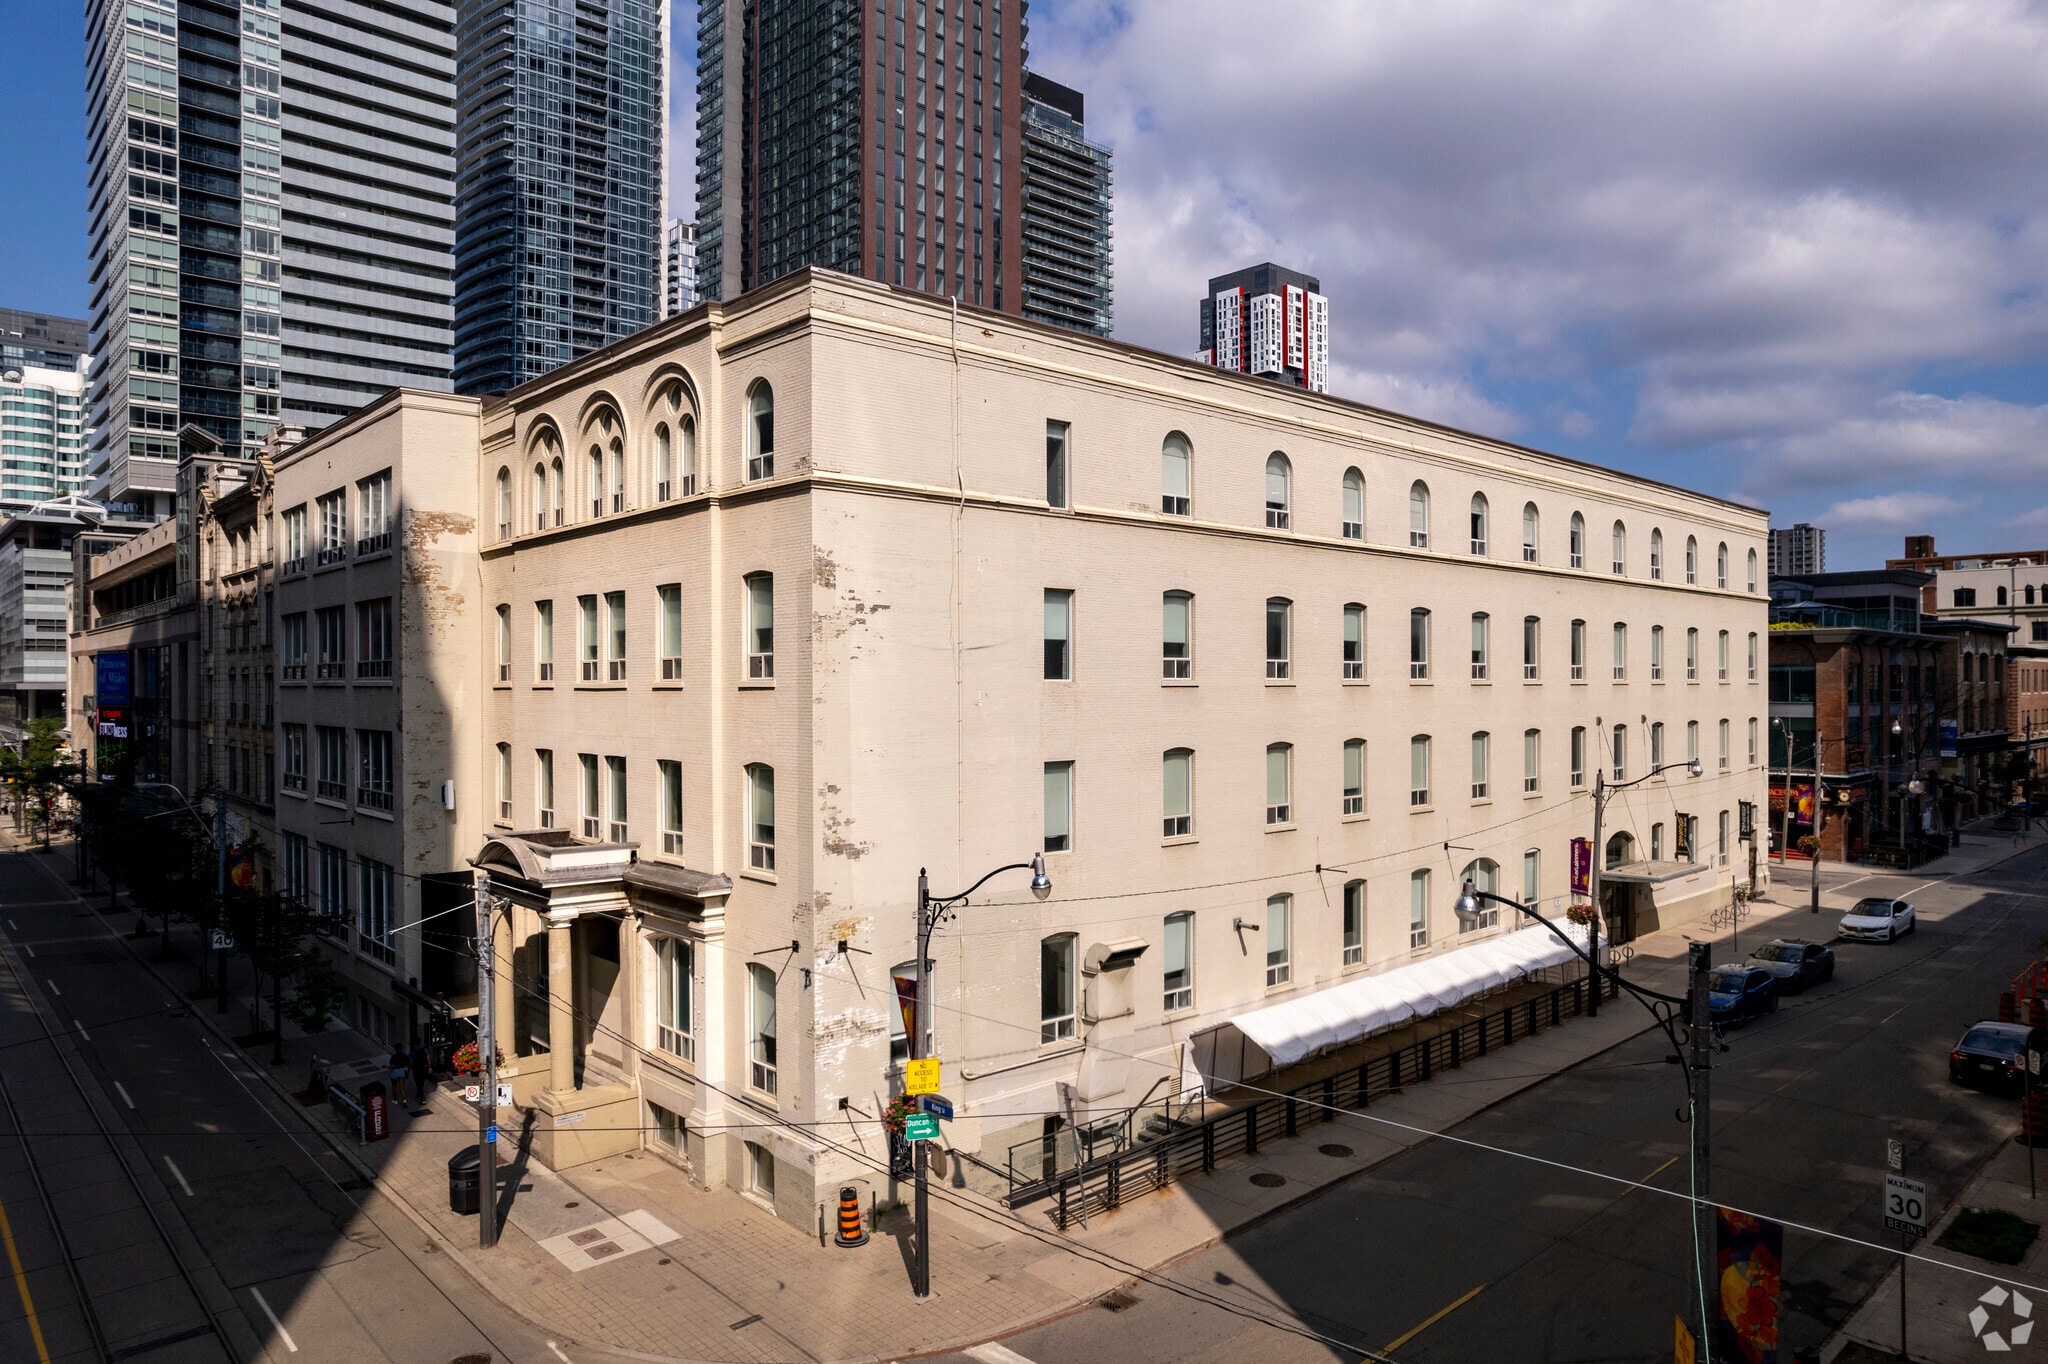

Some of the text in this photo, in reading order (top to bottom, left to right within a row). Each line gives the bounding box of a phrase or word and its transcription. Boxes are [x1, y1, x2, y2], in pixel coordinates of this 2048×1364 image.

[99, 658, 126, 669] Princess
[215, 936, 232, 945] 40
[931, 1103, 941, 1114] King
[907, 1119, 930, 1127] Duncan
[1887, 1178, 1924, 1194] MAXIMUM
[1889, 1194, 1922, 1220] 30
[1887, 1219, 1924, 1237] BEGINS
